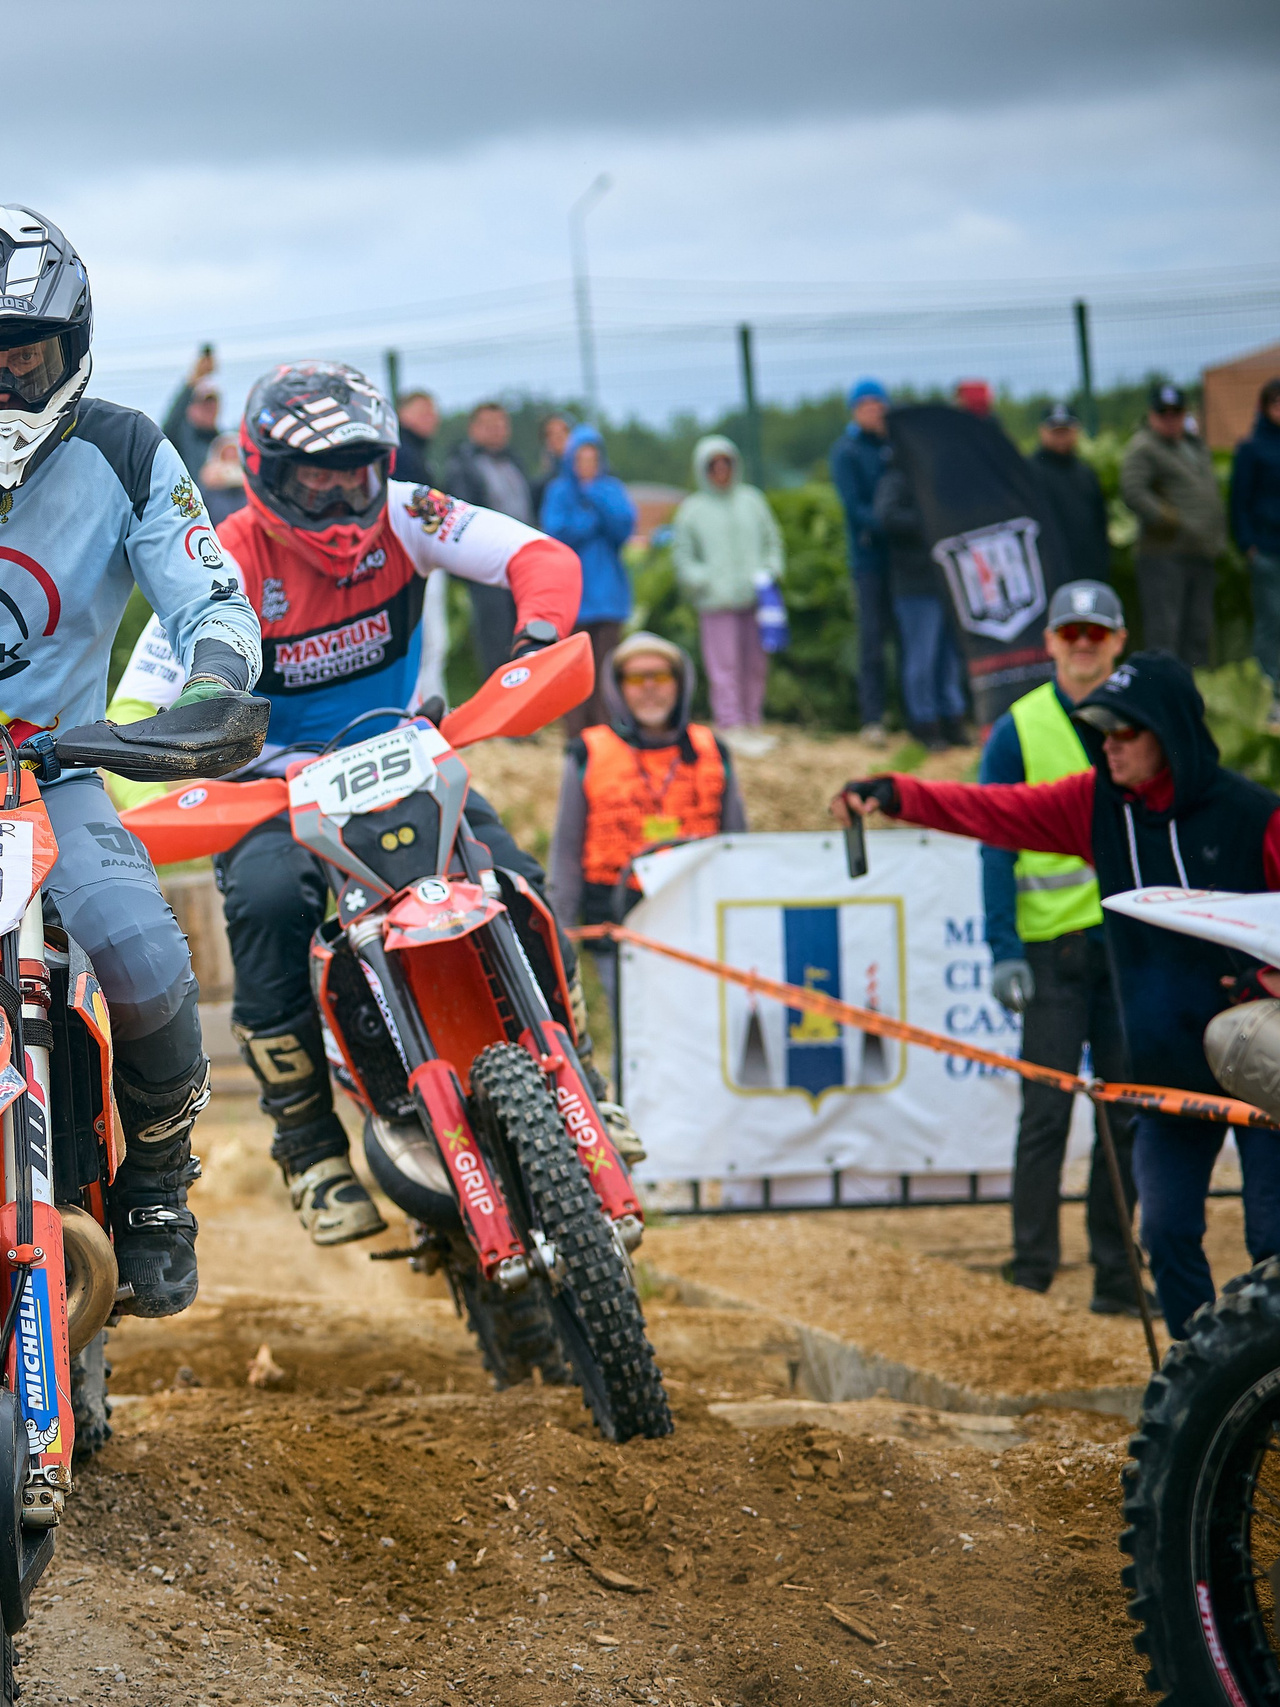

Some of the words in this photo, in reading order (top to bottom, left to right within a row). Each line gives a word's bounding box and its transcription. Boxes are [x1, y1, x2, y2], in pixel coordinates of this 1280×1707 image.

[277, 612, 389, 665] MAYTUN
[286, 649, 382, 685] ENDURO
[330, 748, 411, 802] 125
[442, 1123, 495, 1215] X-GRIP
[59, 1279, 68, 1366] FACTORY
